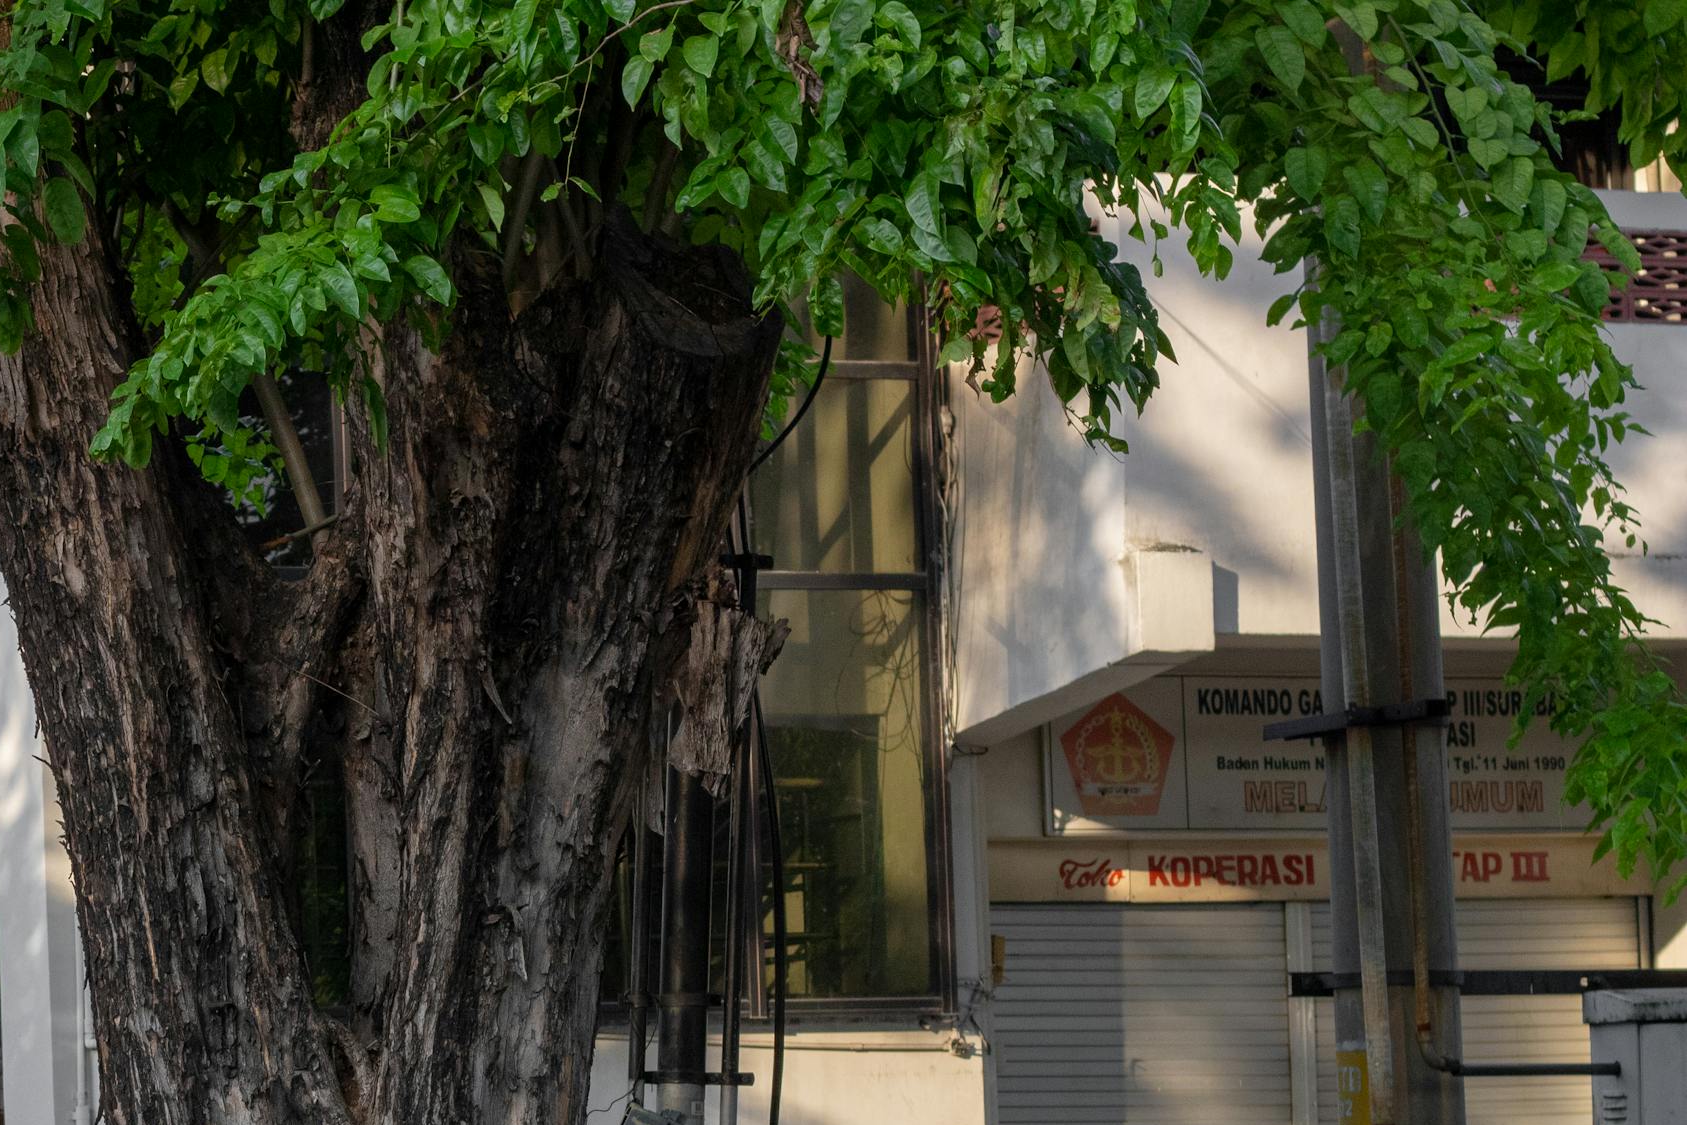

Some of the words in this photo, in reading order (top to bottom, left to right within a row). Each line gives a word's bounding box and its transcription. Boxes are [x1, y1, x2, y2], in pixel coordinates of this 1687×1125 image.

[1198, 688, 1291, 715] KOMANDO
[1447, 721, 1475, 747] ASI
[1264, 756, 1310, 770] Hukum
[1502, 757, 1529, 770] Juni
[1535, 757, 1565, 770] 1990
[1059, 857, 1124, 889] Toko
[1148, 854, 1315, 887] KOPERASI
[1510, 851, 1550, 881] III
